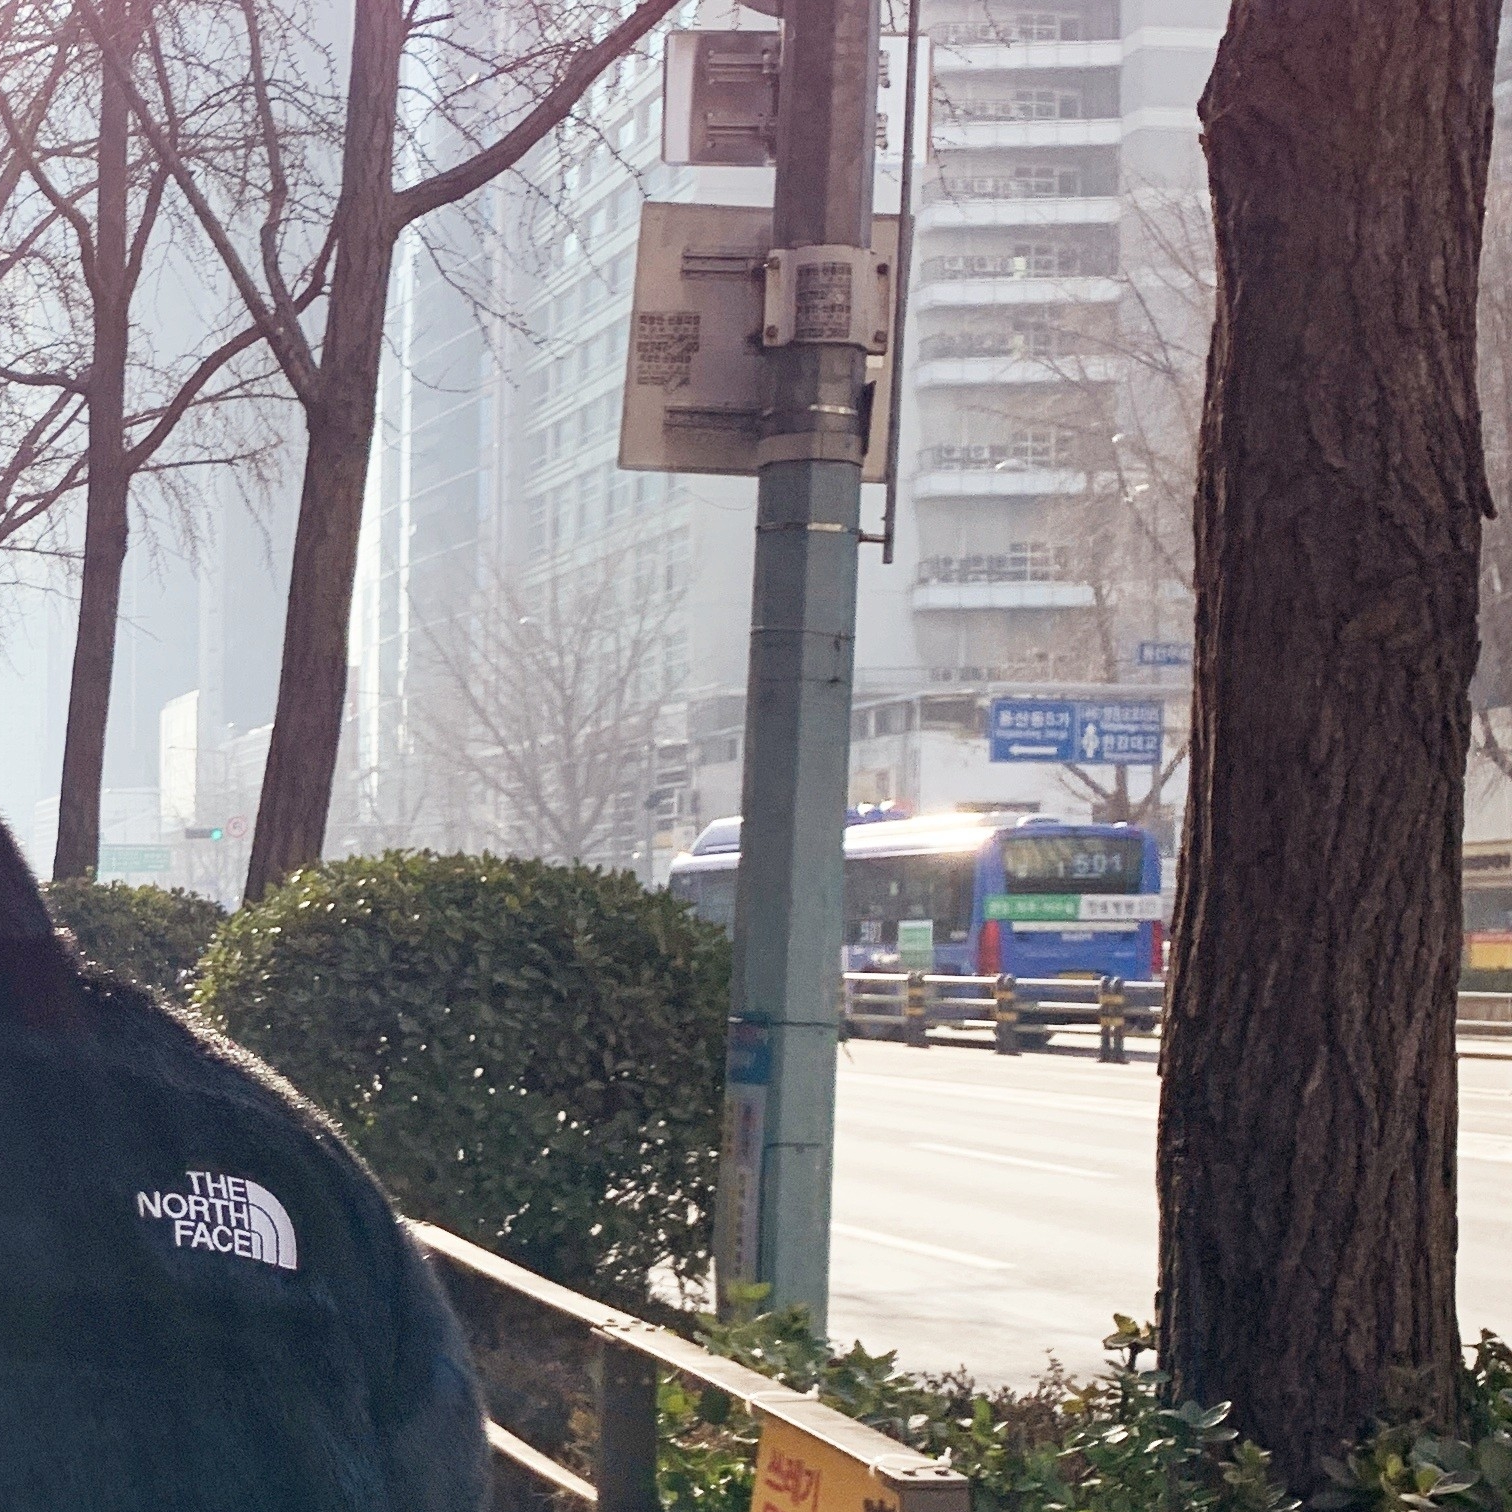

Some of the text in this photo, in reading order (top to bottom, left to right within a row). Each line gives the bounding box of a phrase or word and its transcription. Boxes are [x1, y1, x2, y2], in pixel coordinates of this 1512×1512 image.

[186, 1170, 247, 1203] THE
[137, 1190, 251, 1230] NORTH
[174, 1219, 253, 1259] FACE
